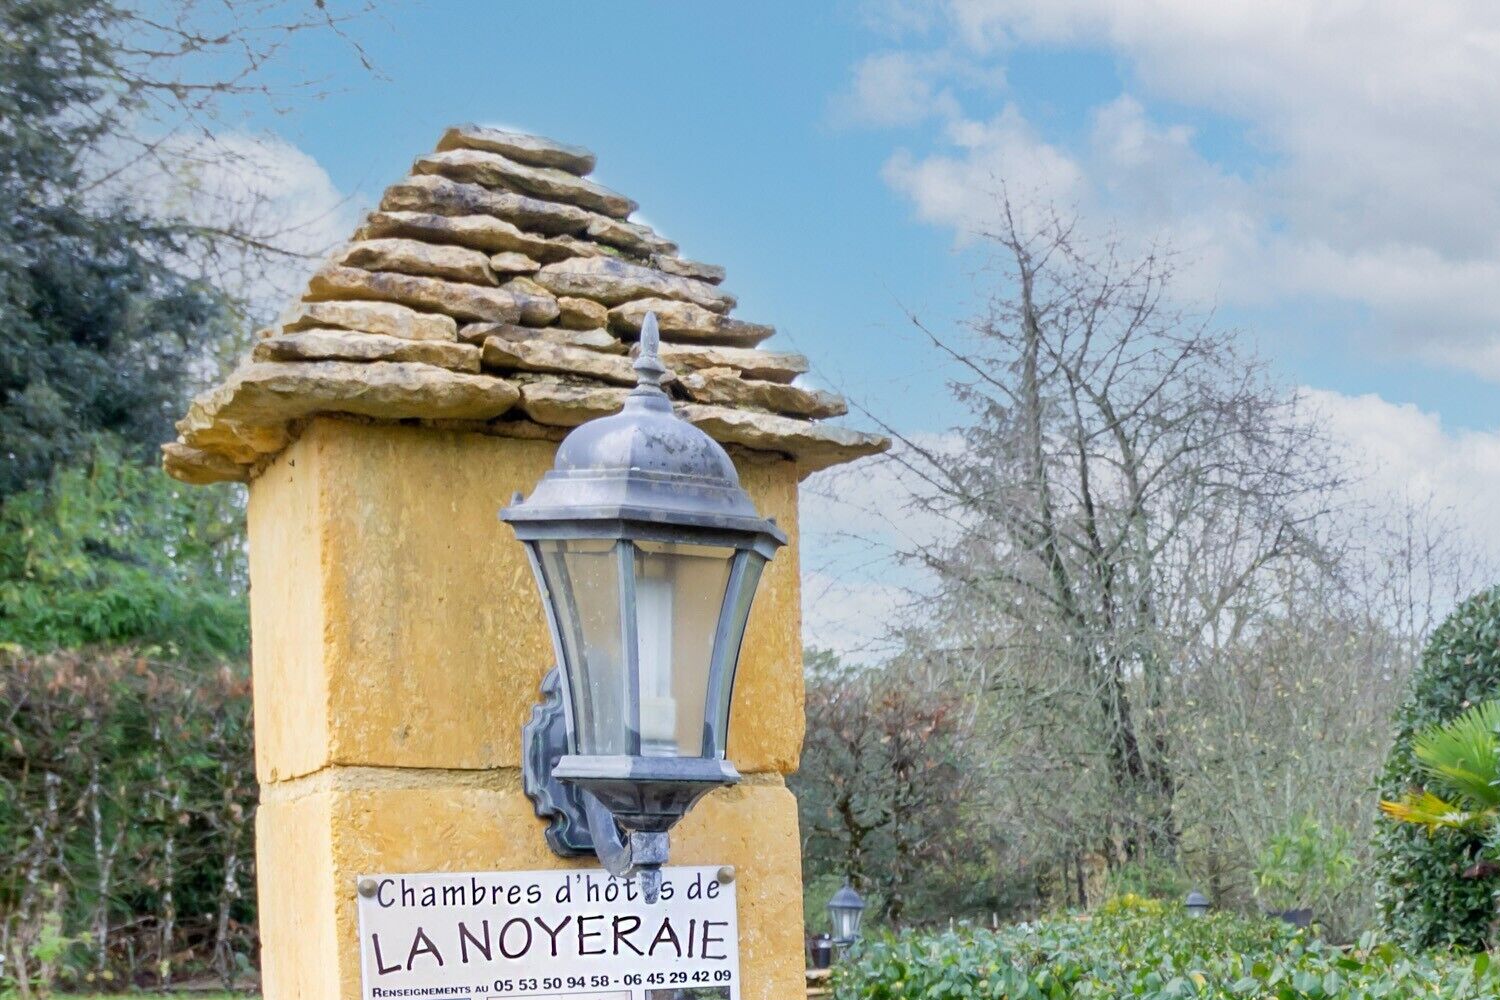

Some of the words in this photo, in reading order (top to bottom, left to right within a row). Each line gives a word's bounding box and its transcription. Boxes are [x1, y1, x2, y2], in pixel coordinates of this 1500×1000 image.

[377, 877, 542, 908] Chambres
[555, 874, 675, 903] d'hôts
[687, 872, 720, 900] de
[372, 926, 444, 975] LA
[458, 915, 729, 964] NOYERAIE
[372, 986, 471, 998] RENSEIGNEMENTS
[475, 985, 489, 993] AU
[493, 980, 513, 992] 05
[519, 978, 538, 991] 53
[543, 977, 562, 989] 50
[567, 976, 586, 988] 94
[591, 975, 610, 987] 58
[623, 973, 642, 986] 06
[646, 972, 665, 985] 45
[669, 971, 688, 983] 29
[692, 970, 710, 982] 42
[714, 969, 732, 981] 09
